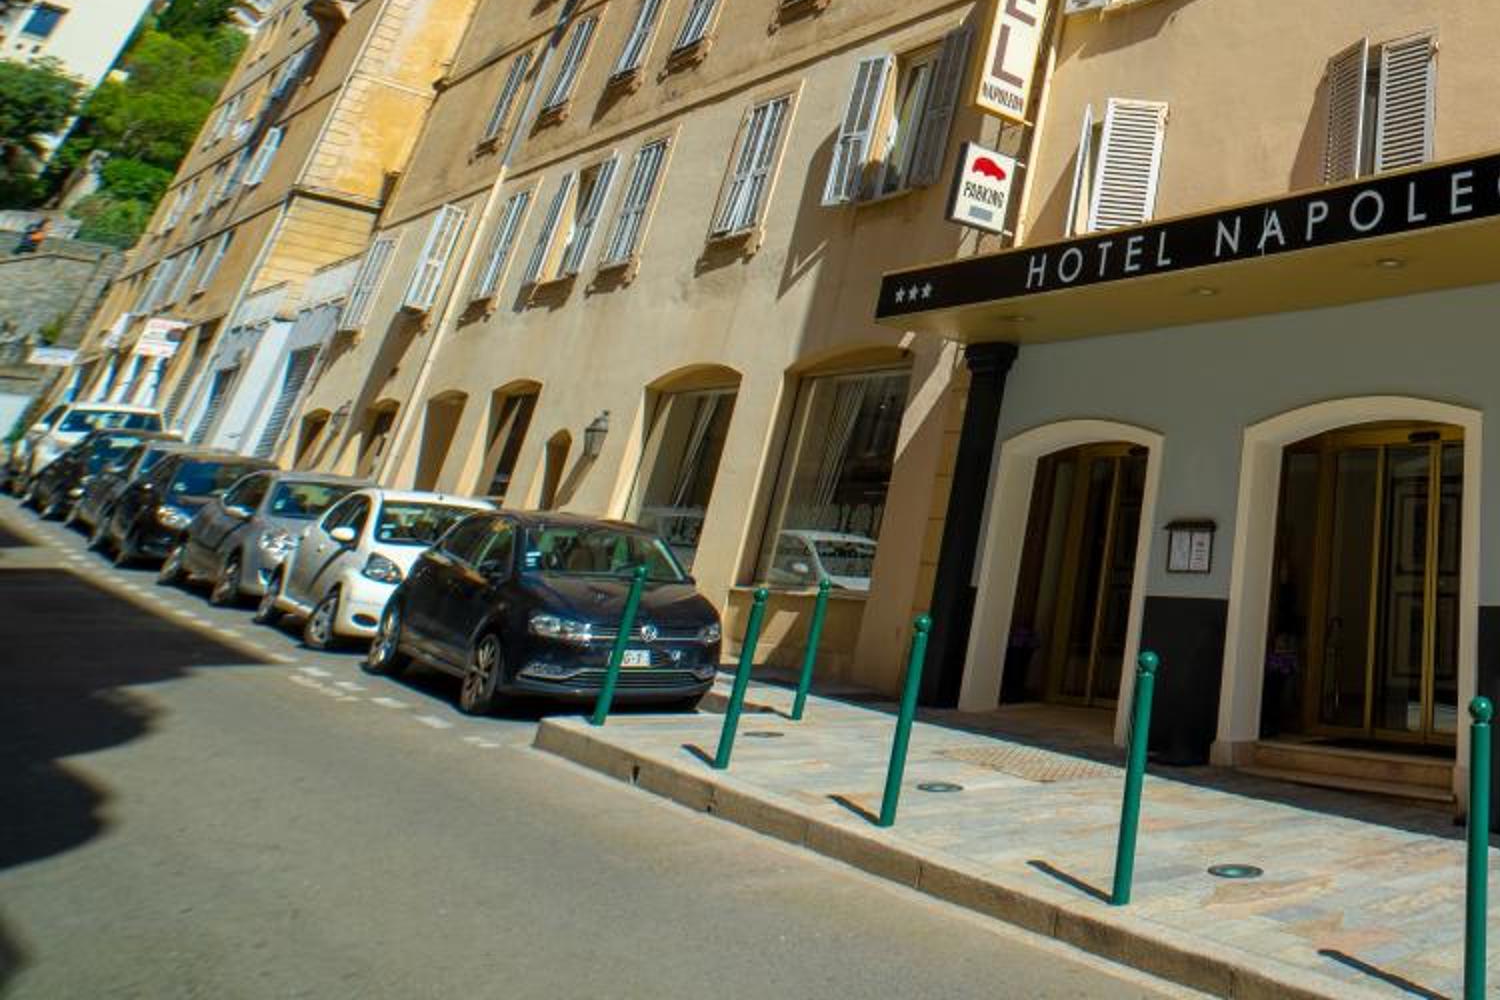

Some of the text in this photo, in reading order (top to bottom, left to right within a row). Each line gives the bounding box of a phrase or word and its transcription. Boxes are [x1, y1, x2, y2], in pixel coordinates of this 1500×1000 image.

[982, 80, 1024, 112] NAPOLEON
[963, 180, 1005, 208] PARKING
[1025, 229, 1172, 289] HOTEL
